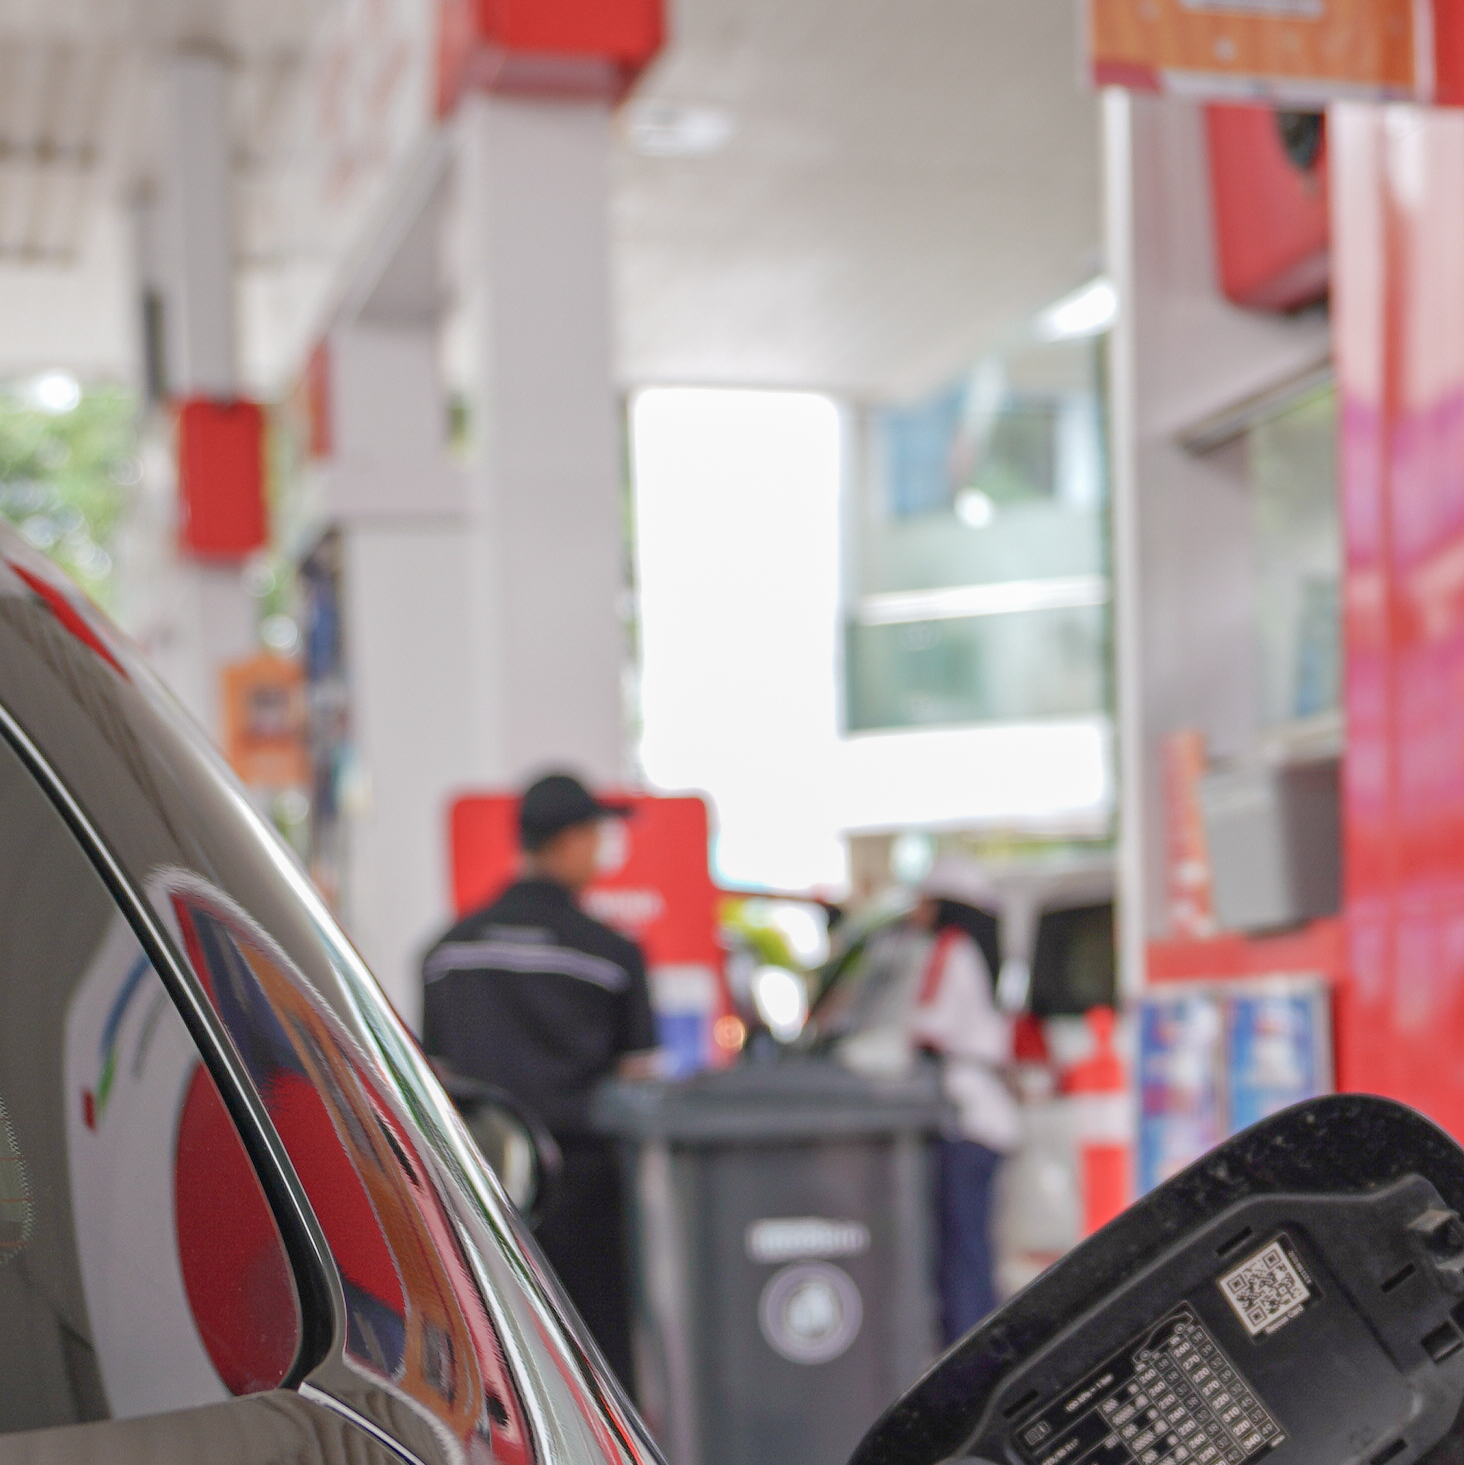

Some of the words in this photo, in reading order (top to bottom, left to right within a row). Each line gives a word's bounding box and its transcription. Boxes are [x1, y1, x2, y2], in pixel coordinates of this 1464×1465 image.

[1139, 1369, 1156, 1384] 260
[1174, 1343, 1191, 1358] 260
[1149, 1381, 1166, 1397] 260
[1183, 1355, 1200, 1370] 270
[1158, 1394, 1175, 1410] 220
[1193, 1367, 1210, 1383] 220
[1168, 1407, 1185, 1423] 260
[1203, 1380, 1220, 1396] 270
[1178, 1420, 1195, 1436] 220
[1212, 1393, 1230, 1409] 220
[1188, 1433, 1205, 1449] 260
[1223, 1407, 1240, 1422] 310
[1199, 1447, 1216, 1462] 220
[1233, 1420, 1250, 1436] 220
[1243, 1434, 1261, 1450] 340
